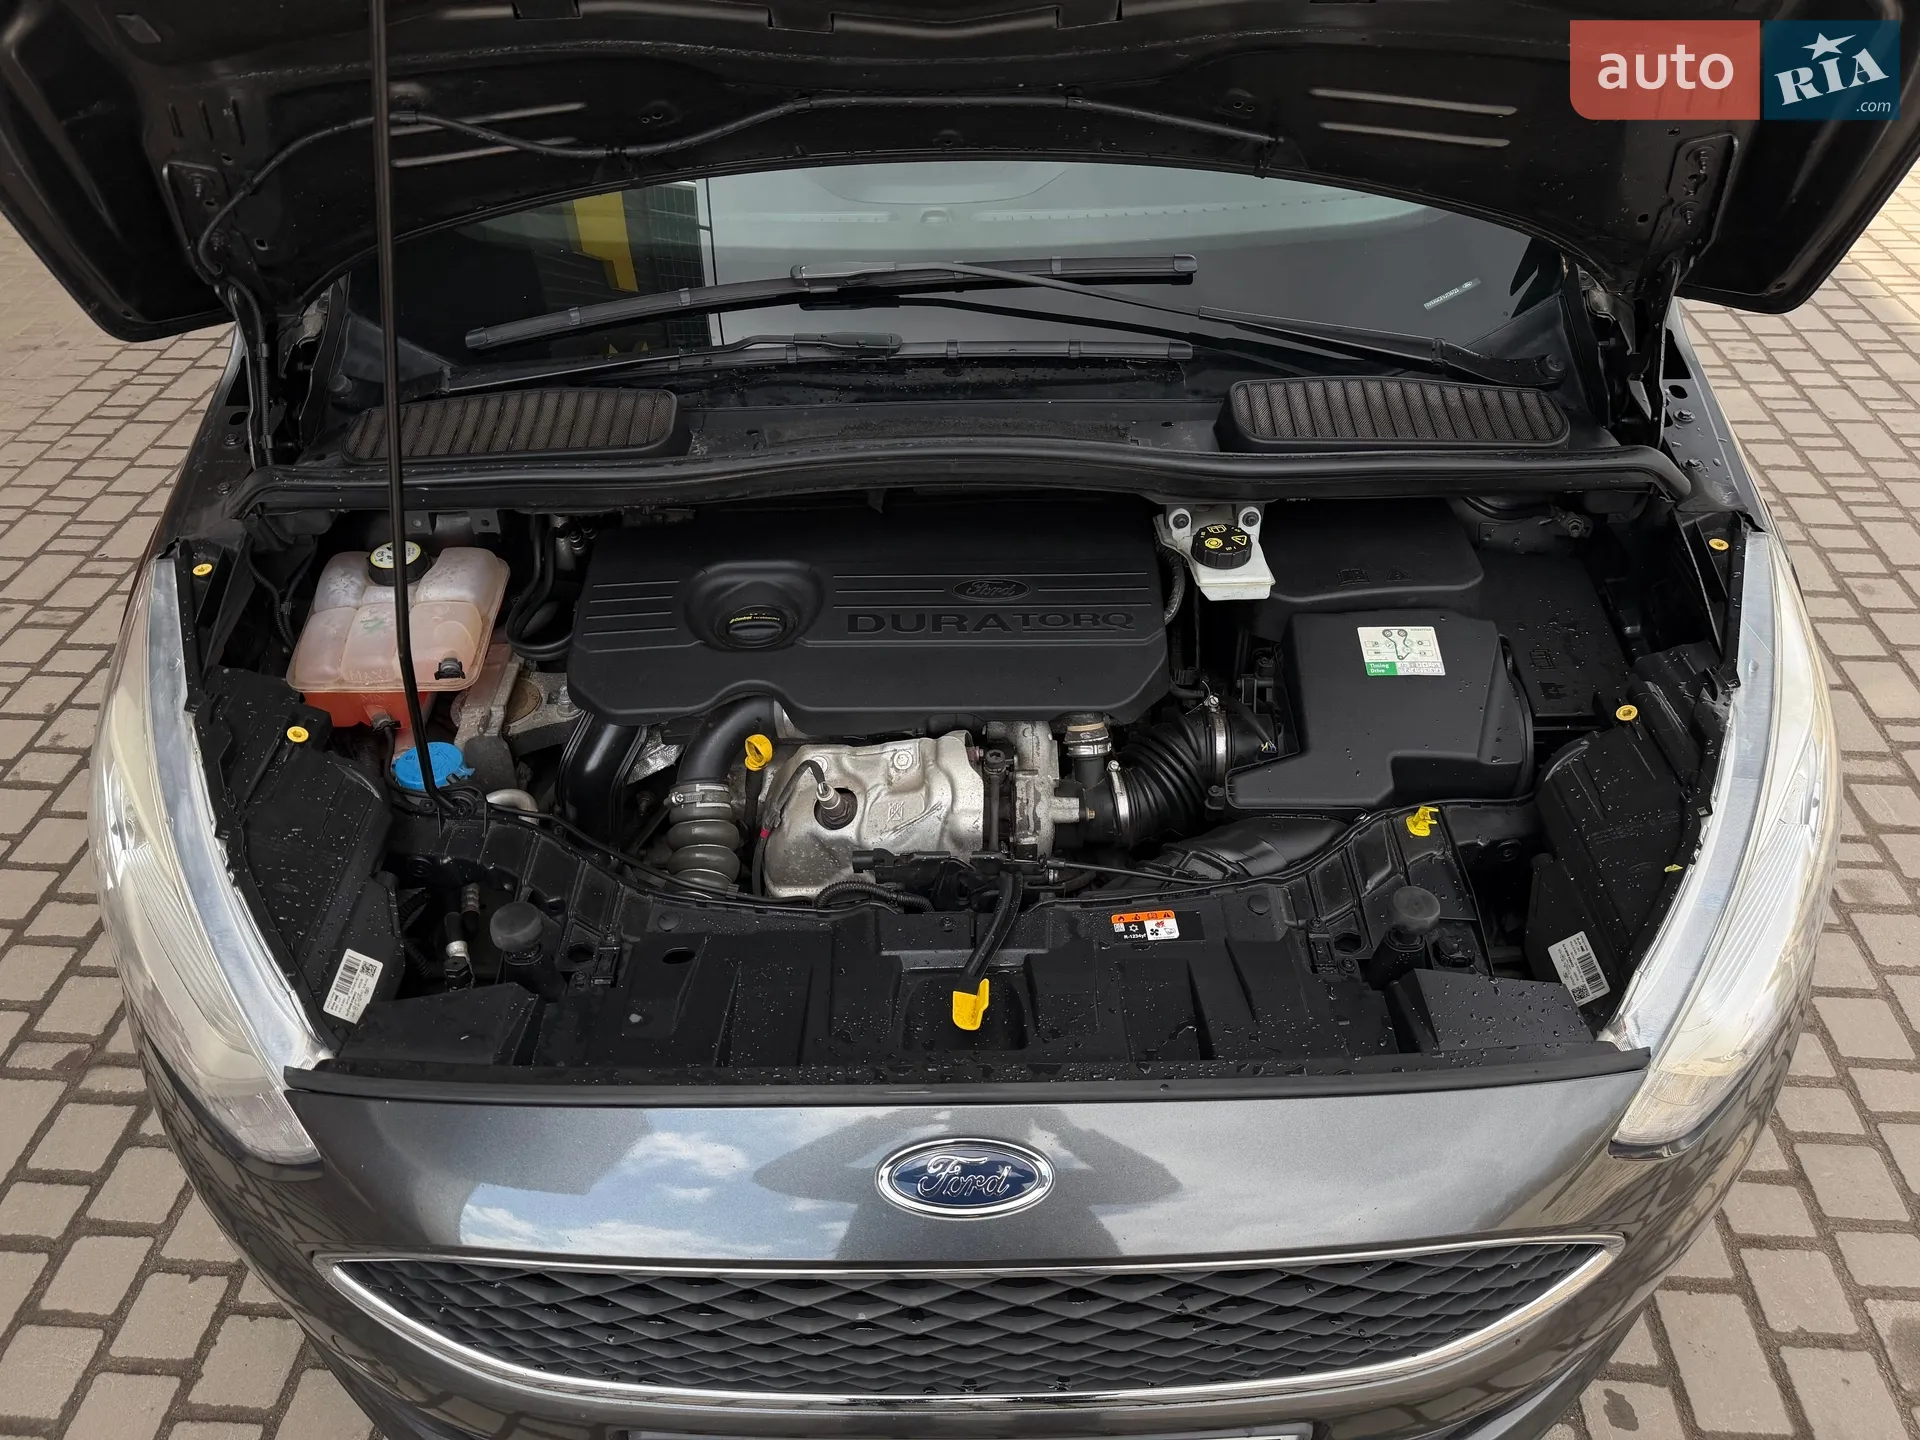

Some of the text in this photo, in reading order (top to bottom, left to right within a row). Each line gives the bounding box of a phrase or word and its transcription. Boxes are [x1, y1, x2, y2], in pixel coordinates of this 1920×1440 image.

[966, 580, 1016, 597] Ford
[847, 612, 1135, 634] DURATORQ
[916, 1153, 1012, 1198] Ford
